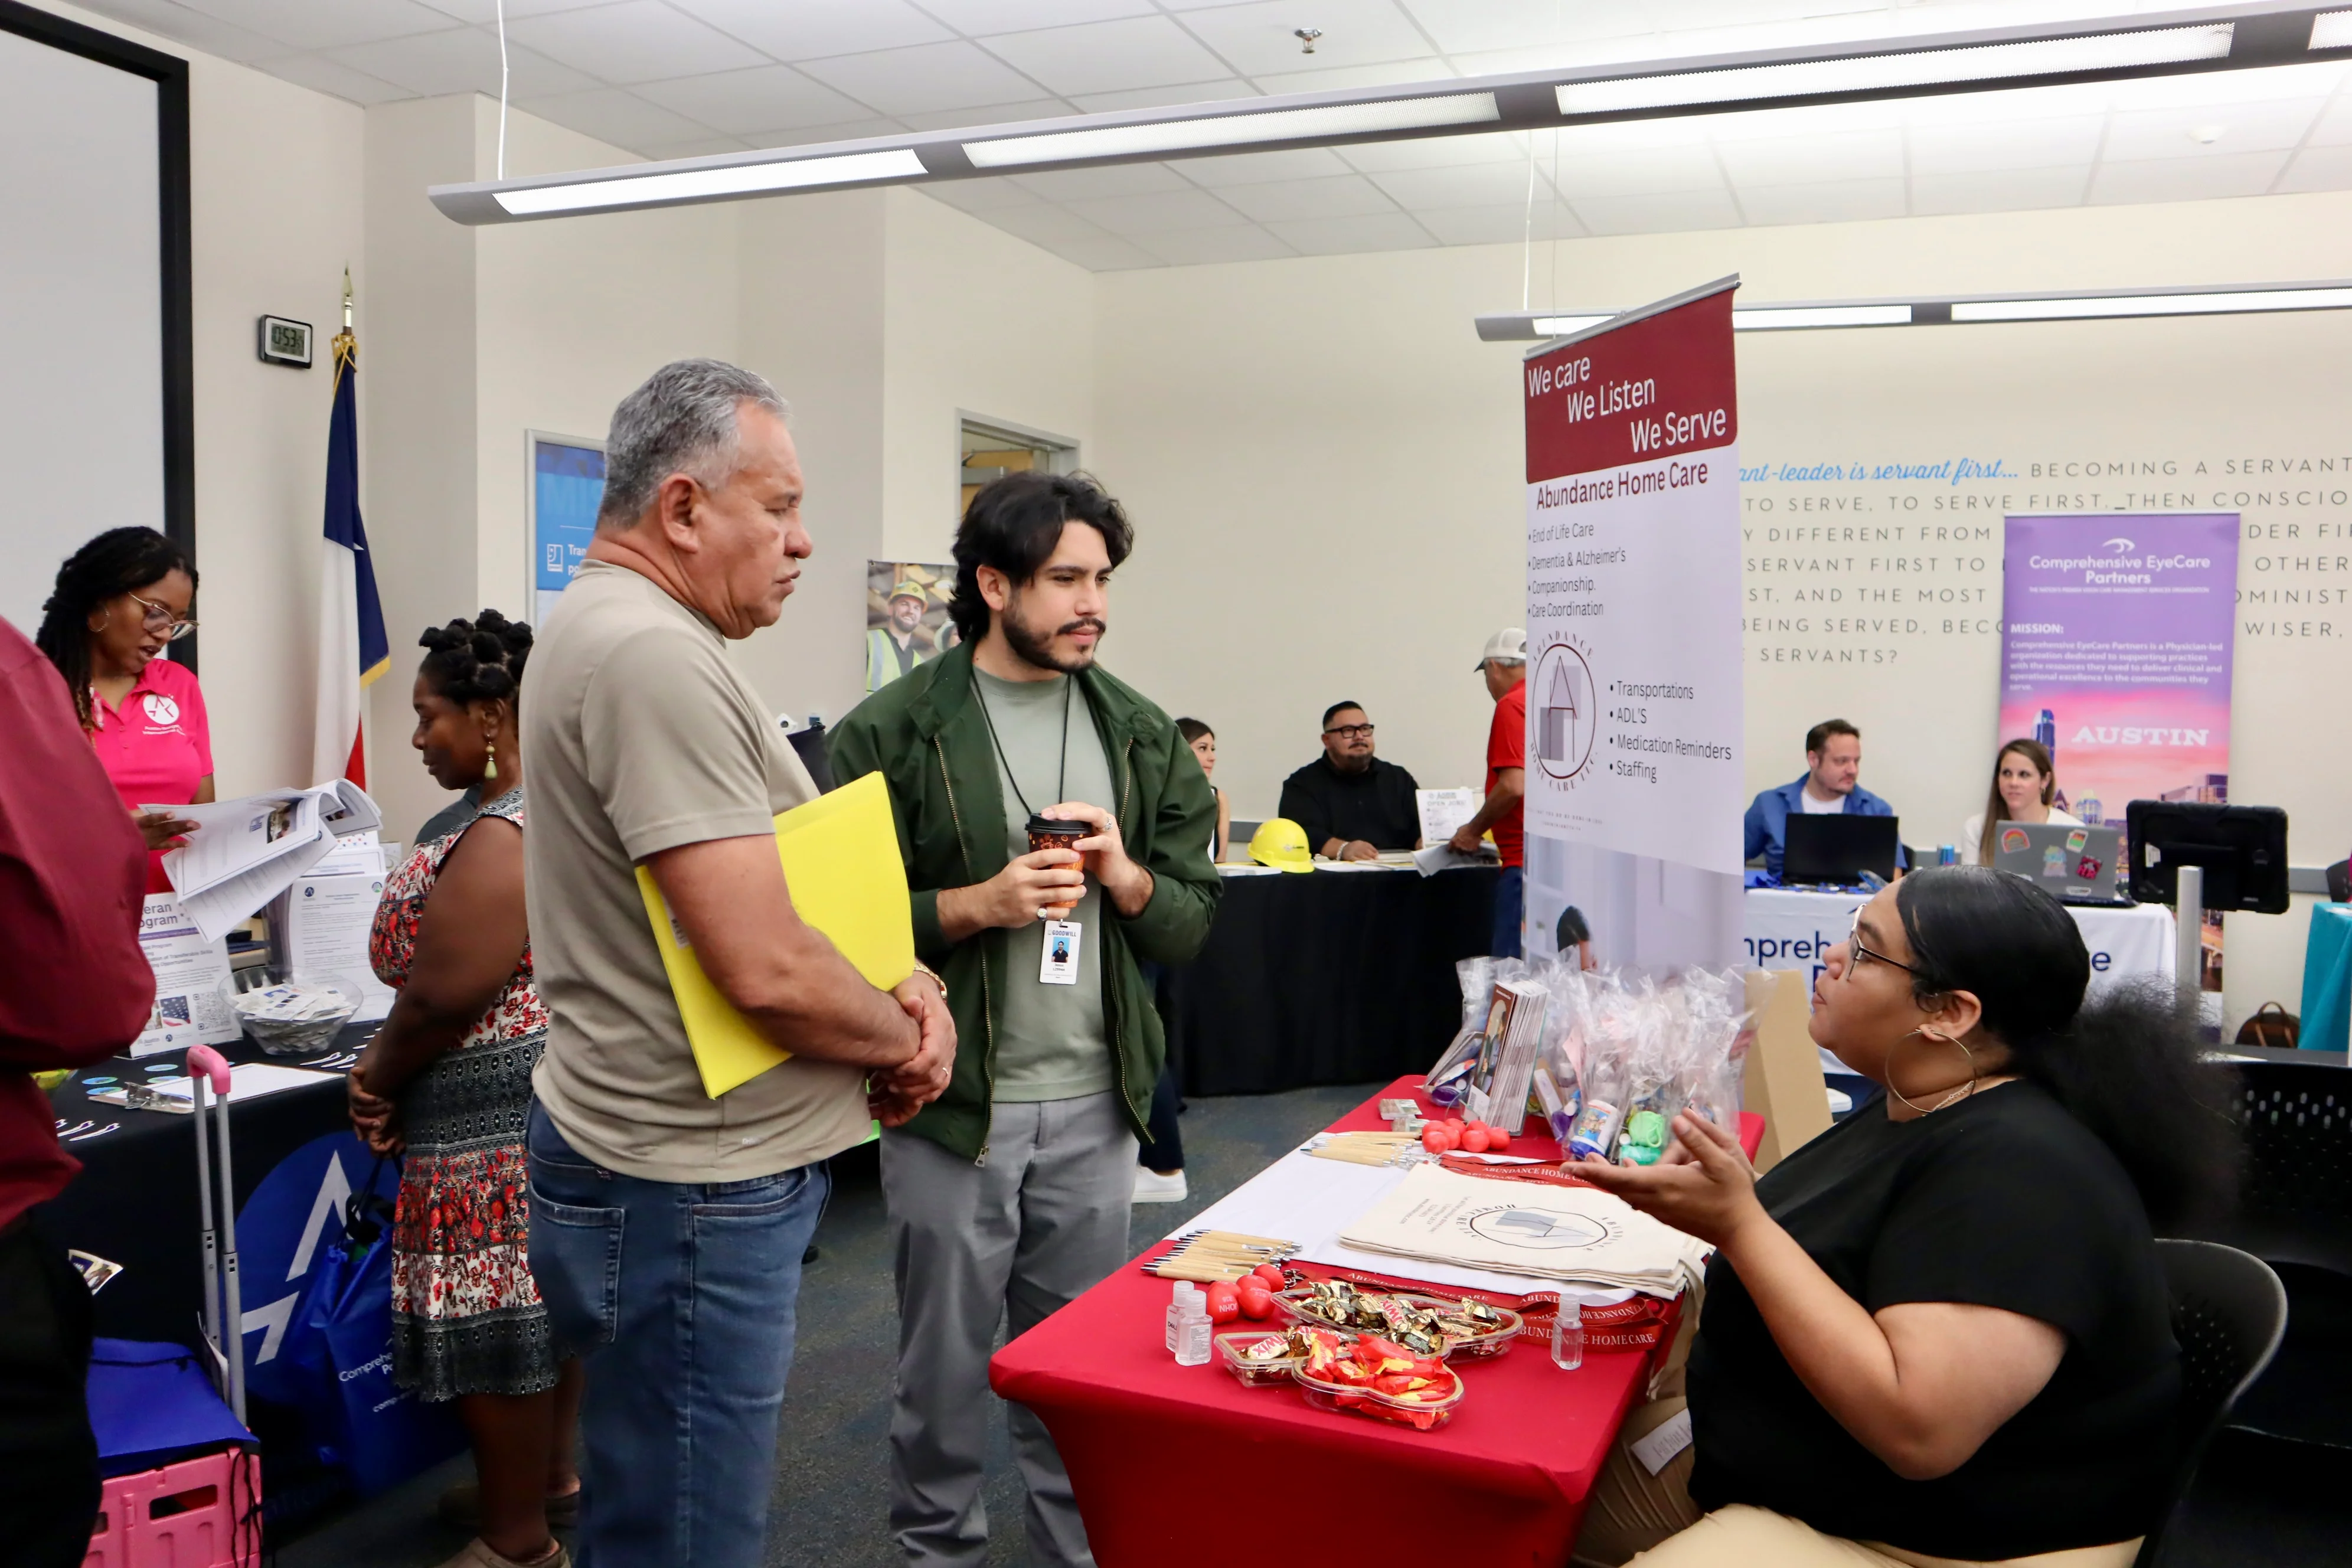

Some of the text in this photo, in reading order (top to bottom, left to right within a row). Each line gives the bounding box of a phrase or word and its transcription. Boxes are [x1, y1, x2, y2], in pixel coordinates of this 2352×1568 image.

[1528, 357, 1591, 397] We care
[1567, 378, 1655, 424] We Listen
[1630, 408, 1727, 453] We Serve
[1850, 462, 1867, 480] is
[1870, 459, 1951, 479] servant
[2031, 456, 2352, 478] BECOMING A SERVANT
[1536, 462, 1708, 510] Abundance Home Care
[1745, 497, 1774, 512] TO
[1788, 496, 1873, 512] SERVE,
[1889, 496, 1919, 512] TO
[1933, 494, 2013, 511] SERVE
[2125, 492, 2196, 508] THEN
[1532, 522, 1594, 543] End of Life Care
[1769, 527, 1905, 541] DIFFERENT
[1920, 526, 1991, 540] FROM
[1532, 547, 1626, 571] Dementia & Alzheimer's
[1747, 556, 2348, 572] SERVANT FIRST TO OTHER
[2029, 554, 2211, 573] Comprehensive EyeCare
[2085, 570, 2152, 584] Partners
[1794, 589, 1843, 602] AND
[1857, 589, 1903, 602] THE
[1918, 588, 1987, 603] MOST
[1531, 601, 1604, 618] Care Coordination
[1824, 619, 1928, 635] SERVED,
[2245, 621, 2343, 638] WISER,
[2010, 623, 2064, 635] MISSION:
[1760, 648, 1897, 664] SERVANTS?
[1616, 680, 1694, 701] Transportations
[1616, 707, 1648, 724] ADL'S
[1616, 733, 1732, 760] Medication Reminders
[2071, 726, 2210, 747] AUSTIN
[1616, 760, 1657, 784] Staffing
[142, 903, 172, 914] eran
[1482, 1166, 1540, 1176] ABUNDANCE
[1541, 1168, 1572, 1180] HOME
[1252, 1333, 1289, 1357] TWIX
[1592, 1334, 1628, 1345] HOME
[1628, 1333, 1655, 1344] CARE
